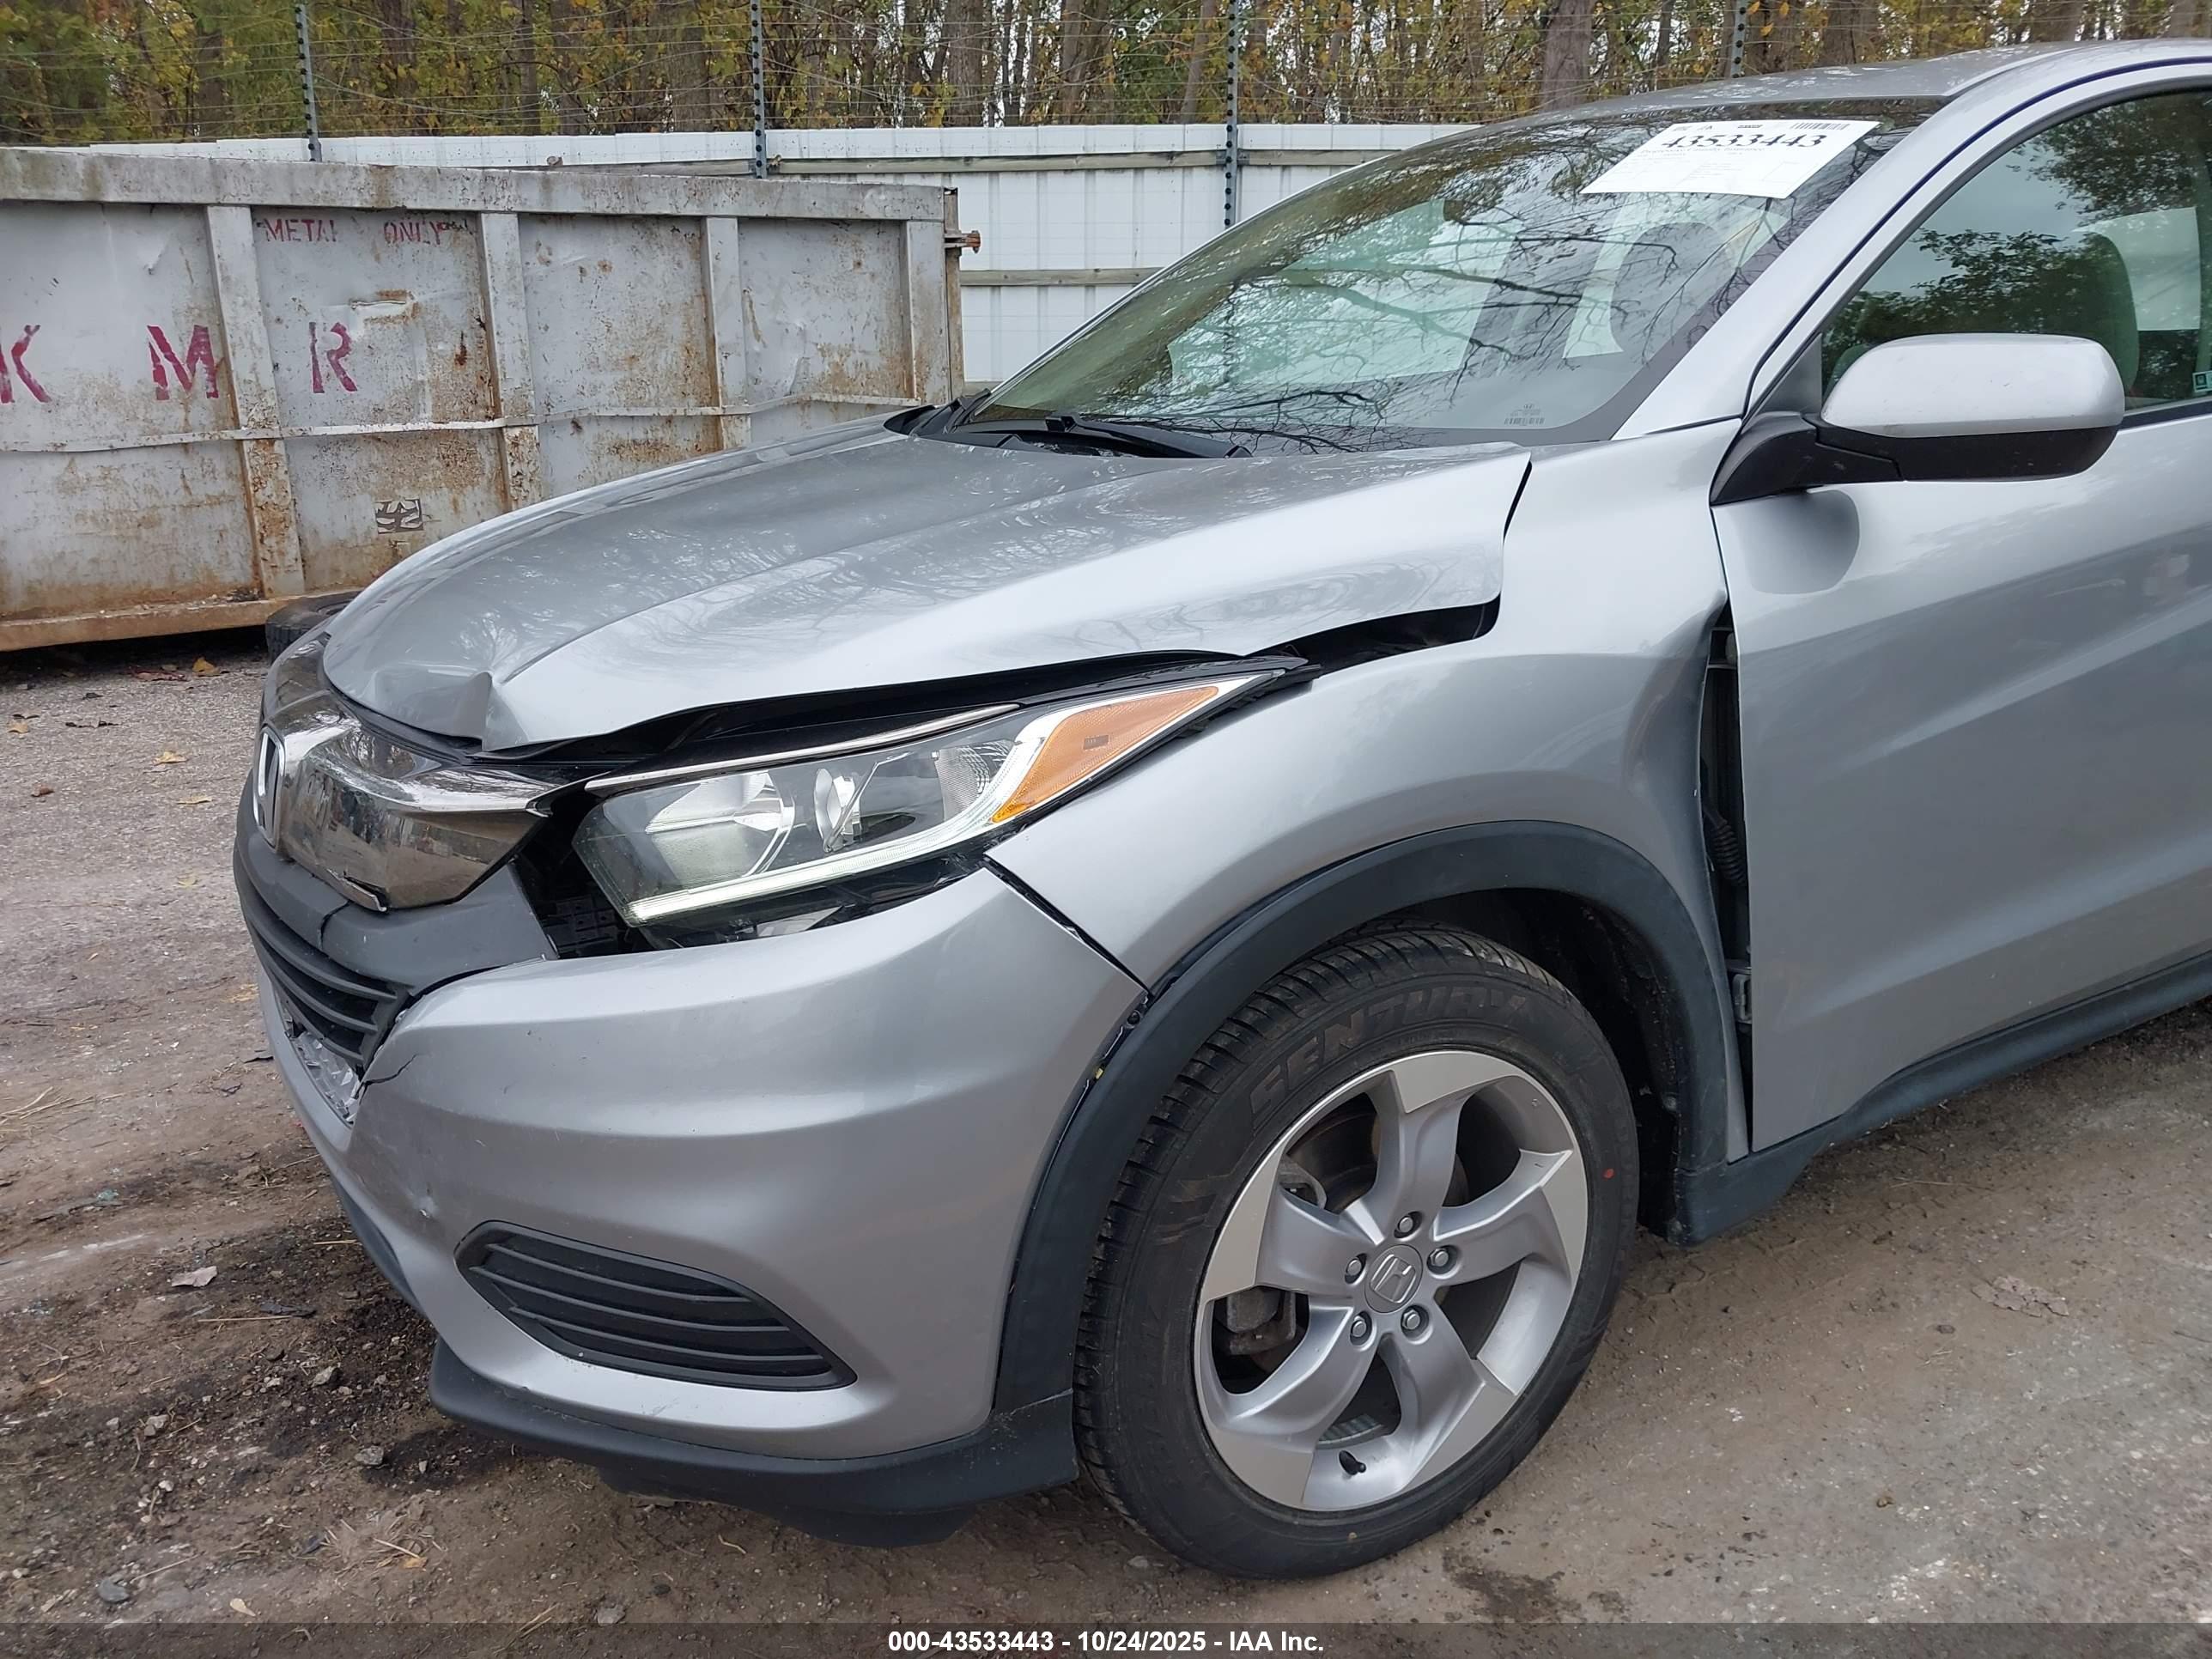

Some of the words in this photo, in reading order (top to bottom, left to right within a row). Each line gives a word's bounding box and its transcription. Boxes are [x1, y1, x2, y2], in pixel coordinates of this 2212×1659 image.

[1662, 133, 1827, 149] 43533443
[383, 220, 445, 246] ONLY
[0, 325, 52, 404] K
[147, 325, 219, 401] M
[309, 321, 358, 393] R
